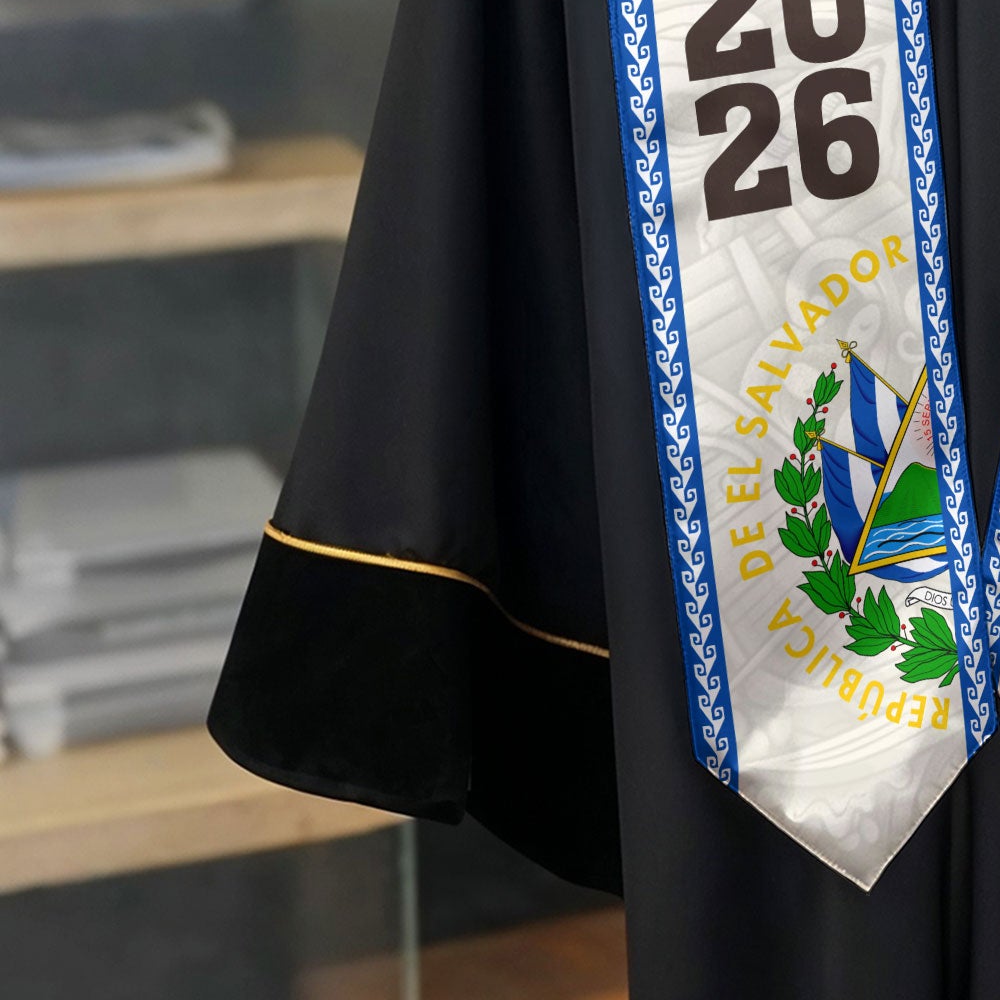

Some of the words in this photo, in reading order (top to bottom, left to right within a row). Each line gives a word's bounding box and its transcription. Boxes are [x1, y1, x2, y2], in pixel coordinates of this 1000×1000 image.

[694, 67, 880, 221] 26
[735, 234, 909, 439] SALVADOR
[727, 457, 762, 504] EL
[730, 521, 774, 581] DE
[924, 590, 948, 607] DIOS
[768, 597, 951, 731] REPÚBLICA
